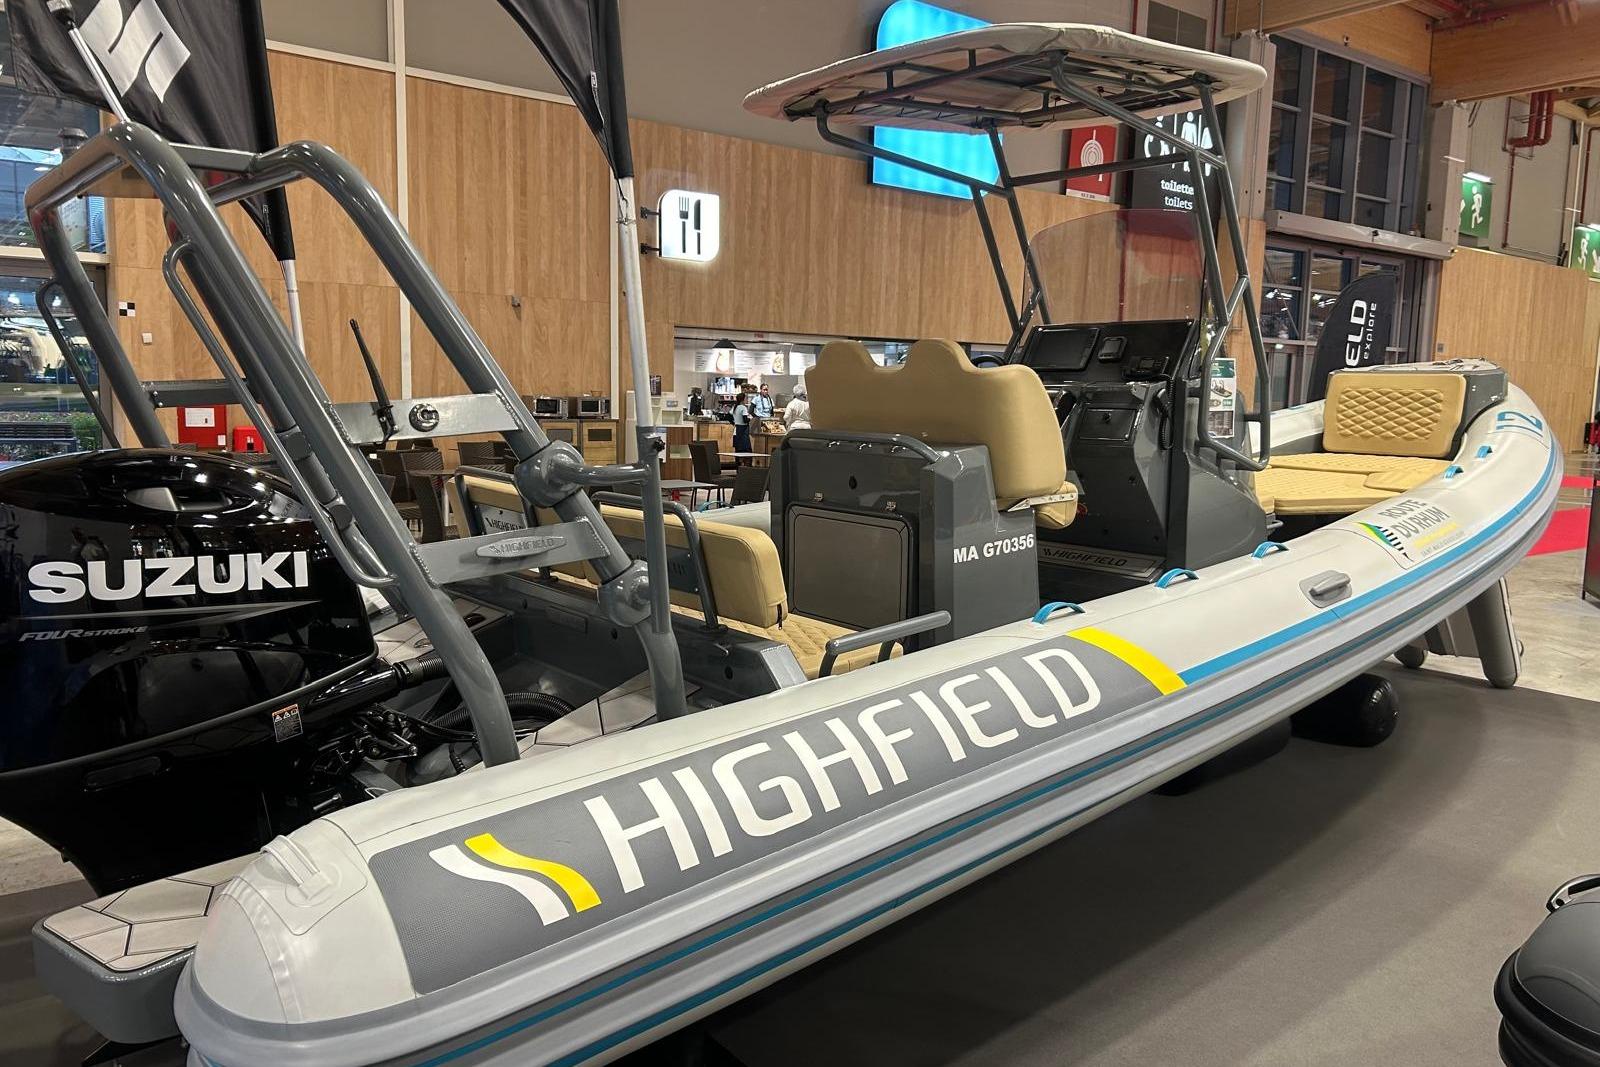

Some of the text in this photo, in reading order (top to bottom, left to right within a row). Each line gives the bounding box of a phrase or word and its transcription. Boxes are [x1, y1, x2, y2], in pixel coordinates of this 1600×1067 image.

[1160, 179, 1194, 196] toilette
[1164, 196, 1193, 210] toilets
[1363, 303, 1377, 360] explore
[1378, 499, 1427, 519] ROUTE
[1391, 506, 1450, 539] DU RHUM
[502, 538, 555, 551] HIGHFIELD
[953, 534, 1034, 563] MA G70356
[1054, 549, 1127, 567] HIGHFIELD
[28, 551, 309, 603] SUZUKI
[19, 628, 82, 641] FOUR
[584, 648, 1101, 894] HIGHFIELD
